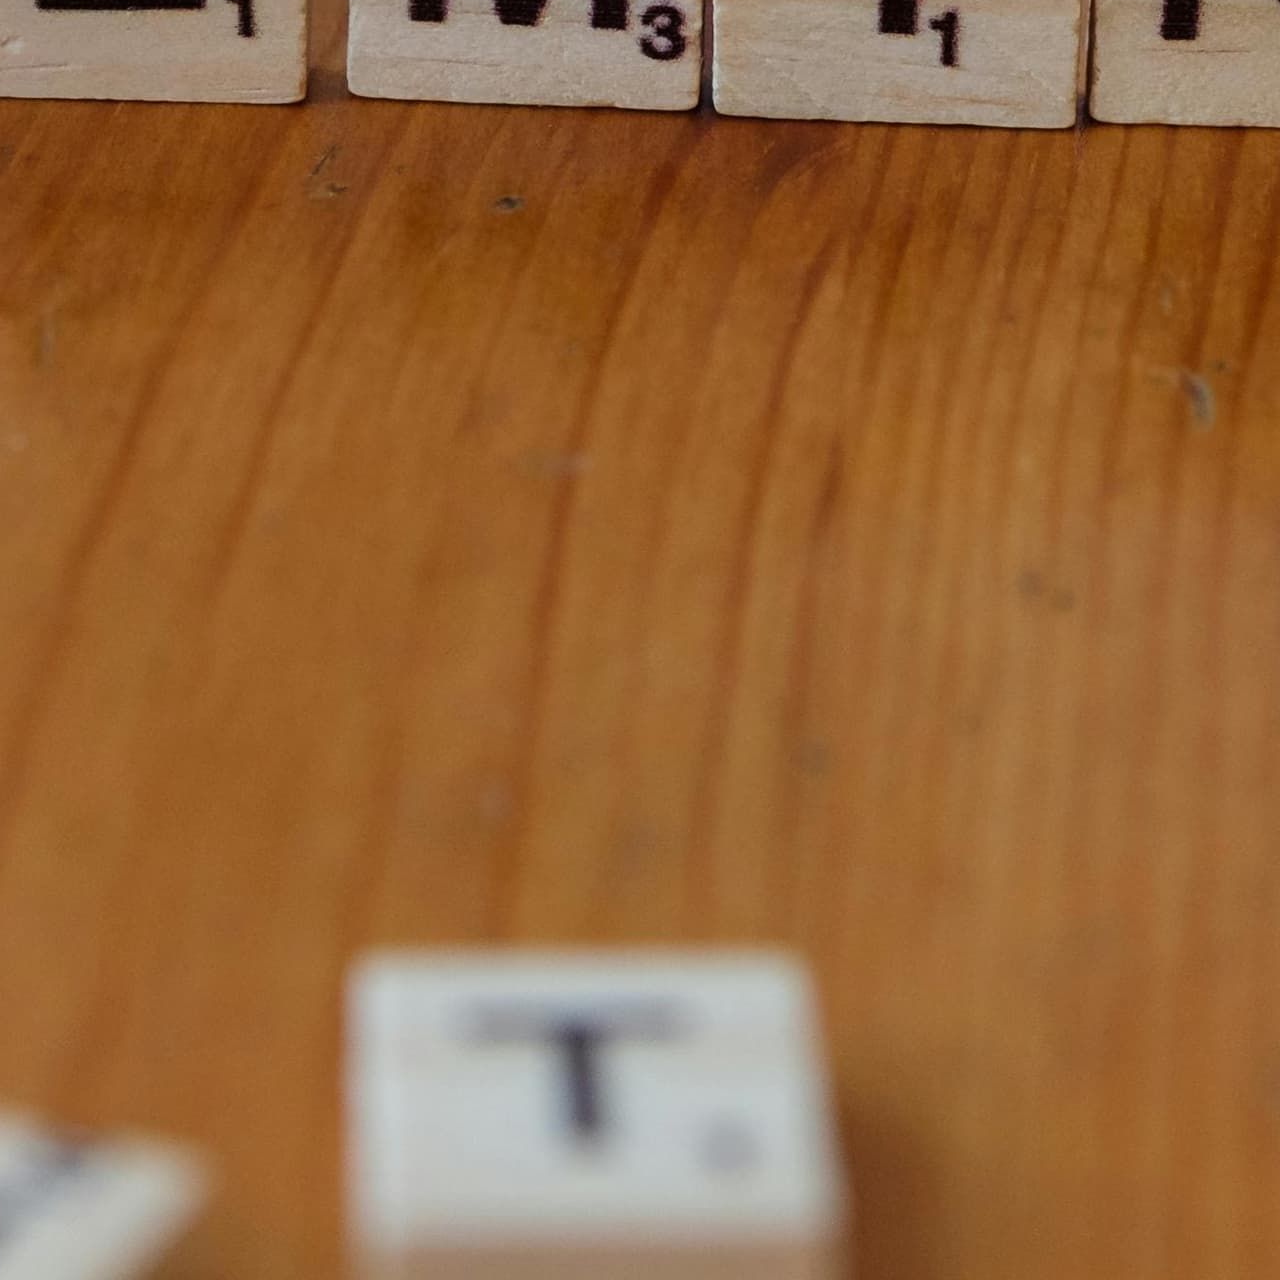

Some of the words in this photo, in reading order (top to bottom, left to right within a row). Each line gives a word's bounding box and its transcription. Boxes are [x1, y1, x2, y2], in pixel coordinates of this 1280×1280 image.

[638, 0, 688, 62] 3
[928, 8, 962, 68] 1
[448, 994, 700, 1150] T
